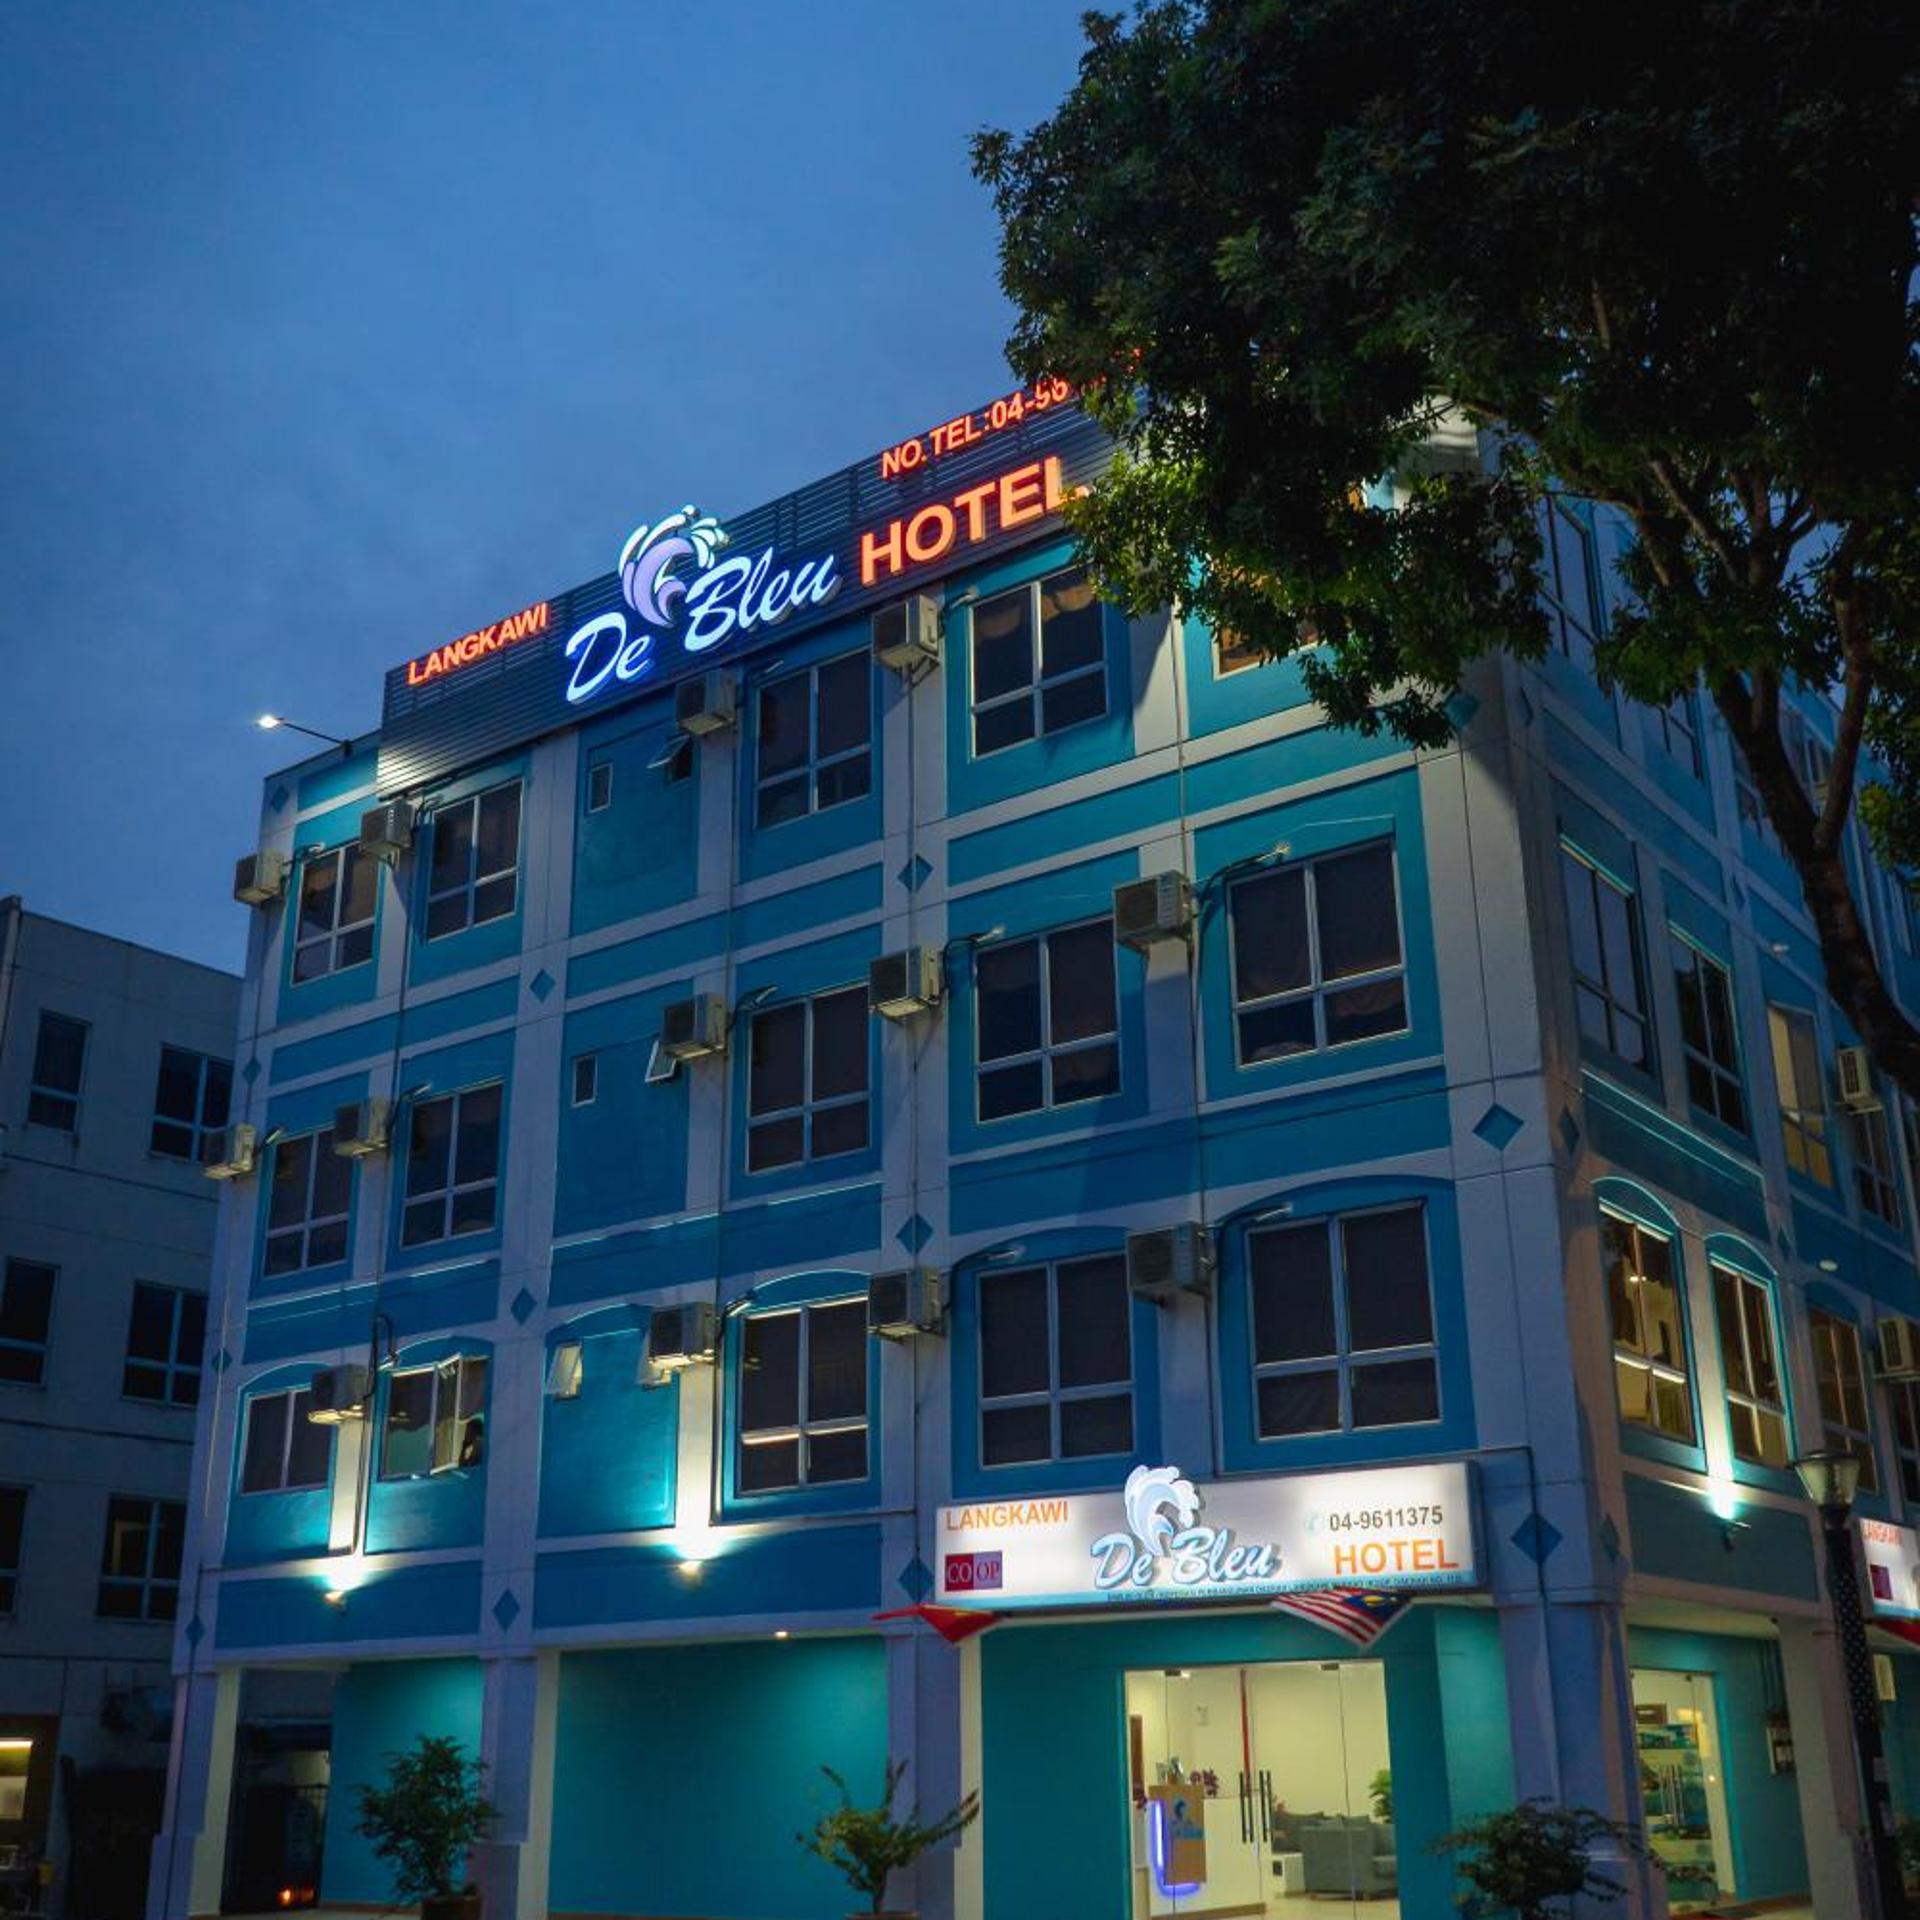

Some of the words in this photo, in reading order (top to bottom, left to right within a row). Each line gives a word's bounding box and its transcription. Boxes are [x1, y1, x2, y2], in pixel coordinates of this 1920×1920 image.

[861, 455, 1090, 586] HOTEL
[407, 602, 548, 685] LANGKAWI
[564, 611, 651, 703] De
[684, 546, 836, 651] Bleu
[945, 1500, 1069, 1531] LANGKAWI
[1329, 1505, 1443, 1532] 04-9611375
[1090, 1532, 1154, 1589] De
[1171, 1526, 1277, 1584] Bleu
[1334, 1538, 1460, 1575] HOTEL
